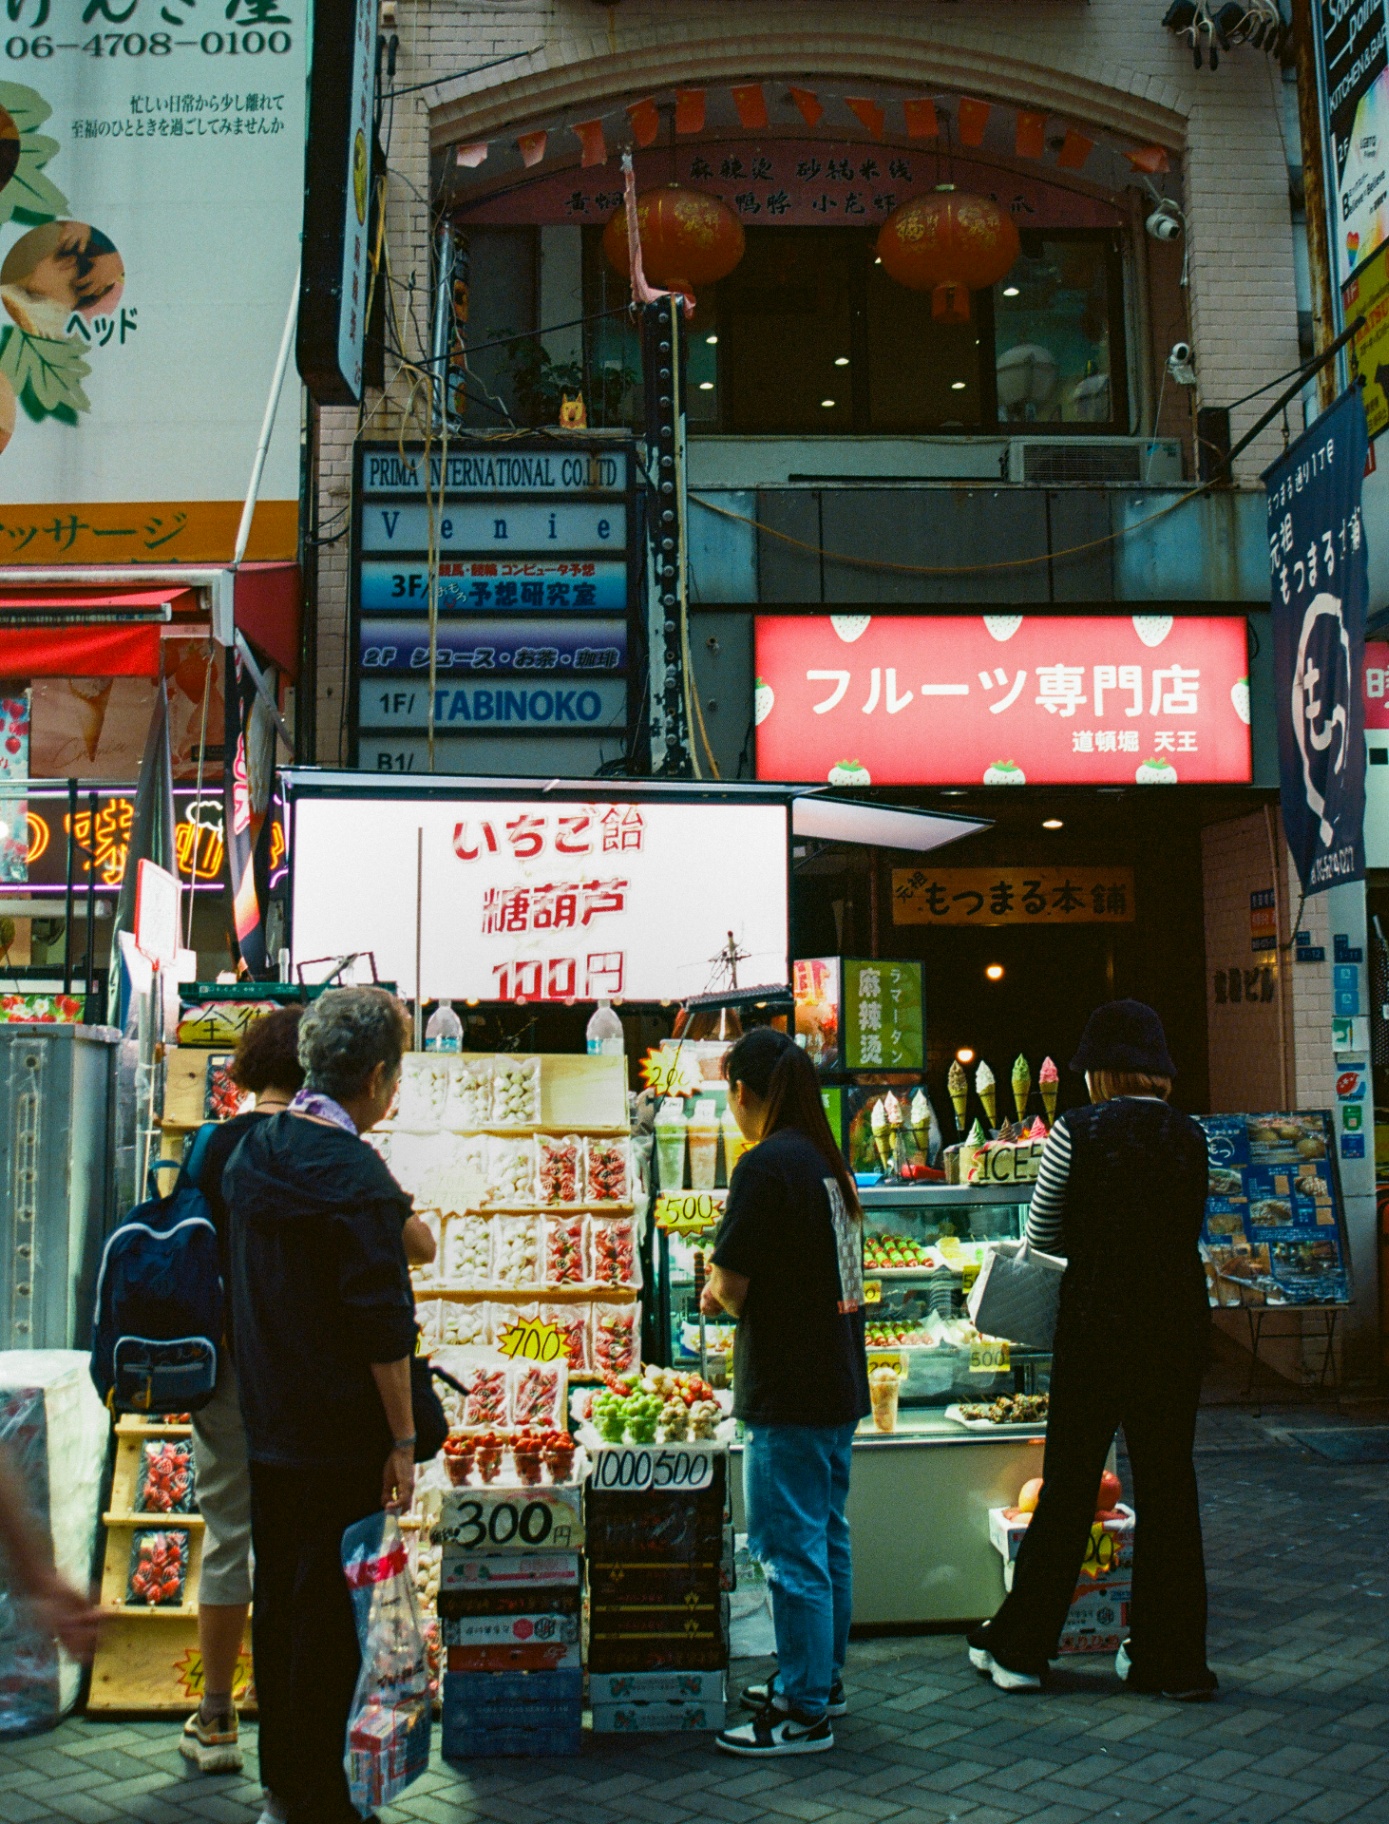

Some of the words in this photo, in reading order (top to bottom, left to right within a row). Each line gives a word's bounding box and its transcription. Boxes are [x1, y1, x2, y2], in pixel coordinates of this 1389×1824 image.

[5, 30, 292, 60] 06-4708-0100
[1329, 54, 1365, 116] KITCHEN
[130, 93, 285, 115] 忙しい日常から少し離れて
[71, 116, 285, 139] 至福のひとときを過ごしてみませんか
[65, 306, 138, 347] ヘッド
[369, 458, 420, 487] PRIMA
[0, 510, 188, 552] ッサージ
[501, 563, 597, 577] コンピュータ予想
[469, 580, 597, 607] 予想研究室
[363, 646, 398, 668] 2F
[434, 689, 602, 722] TABINOKO
[805, 663, 1201, 719] フルーツ専門店
[1071, 730, 1141, 754] 道頓堀
[1154, 731, 1199, 753] 天王
[452, 806, 647, 861] いちご飴
[480, 876, 630, 936] 糖葫芦
[924, 878, 1128, 916] もつまる本舗
[491, 951, 627, 1001] 100円
[665, 1193, 714, 1224] 500
[510, 1326, 561, 1362] 700
[970, 1350, 1006, 1368] 500
[594, 1450, 650, 1489] 1000
[653, 1450, 708, 1487] 500
[456, 1499, 572, 1550] 300円
